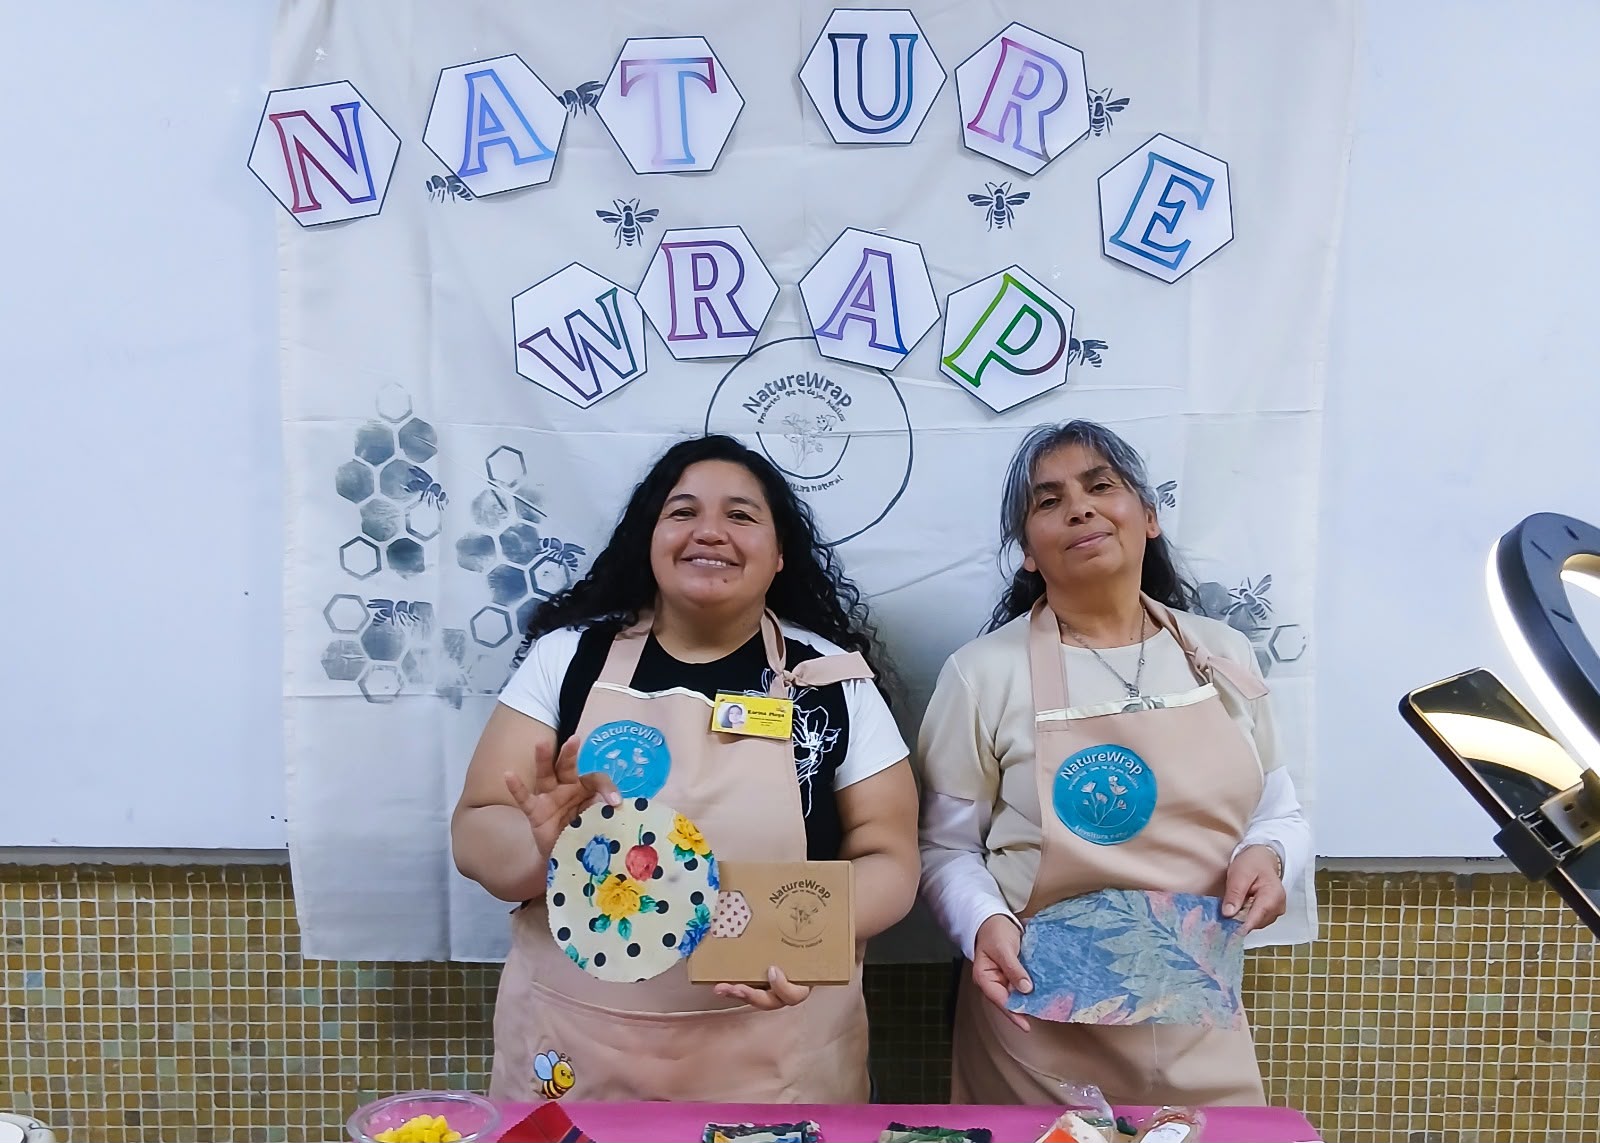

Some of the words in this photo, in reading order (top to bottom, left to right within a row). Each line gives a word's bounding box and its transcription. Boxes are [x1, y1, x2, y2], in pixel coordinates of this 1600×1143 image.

[269, 34, 1215, 271] NATURE
[519, 240, 1067, 401] WRAP
[742, 371, 852, 414] NatureWrap
[1060, 751, 1143, 780] NatureWrap
[769, 878, 831, 904] NatureWrap
